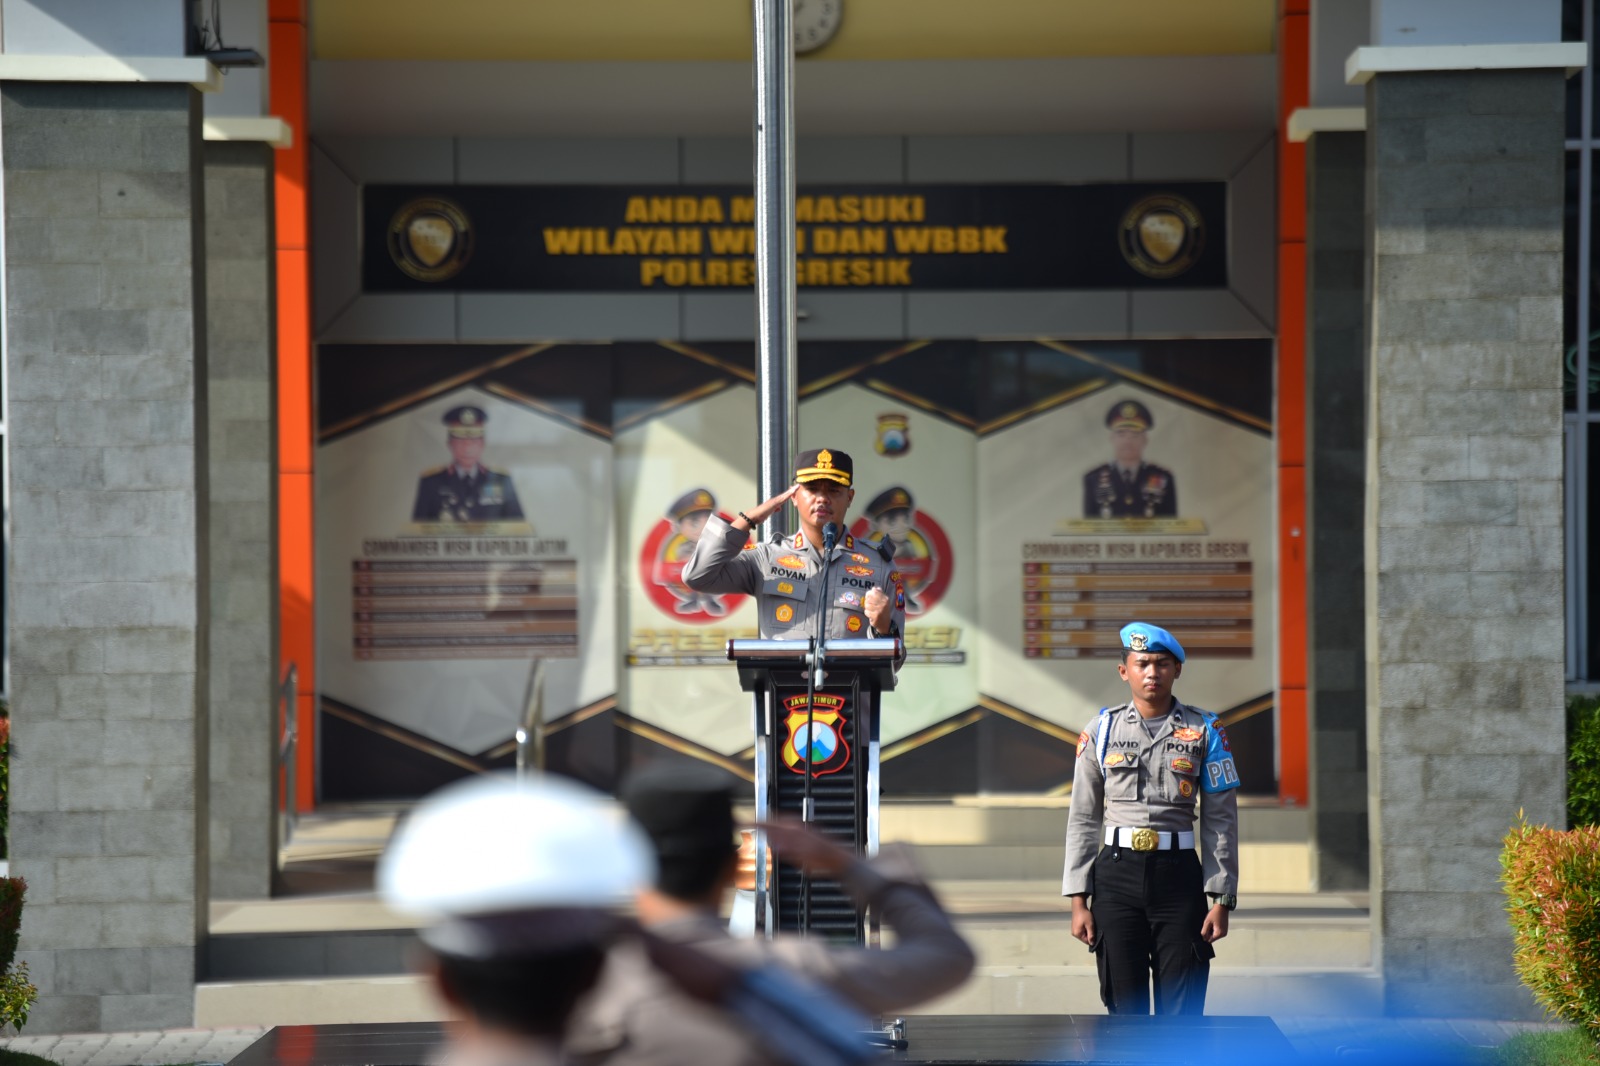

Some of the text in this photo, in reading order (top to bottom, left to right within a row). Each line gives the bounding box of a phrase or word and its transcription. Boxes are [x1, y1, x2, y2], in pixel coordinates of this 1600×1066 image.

[625, 195, 925, 223] ANDA MMASUKI
[544, 228, 702, 255] WILAYAH
[814, 227, 887, 253] DAN
[771, 566, 806, 581] ROVAN
[813, 696, 837, 706] TIMUR
